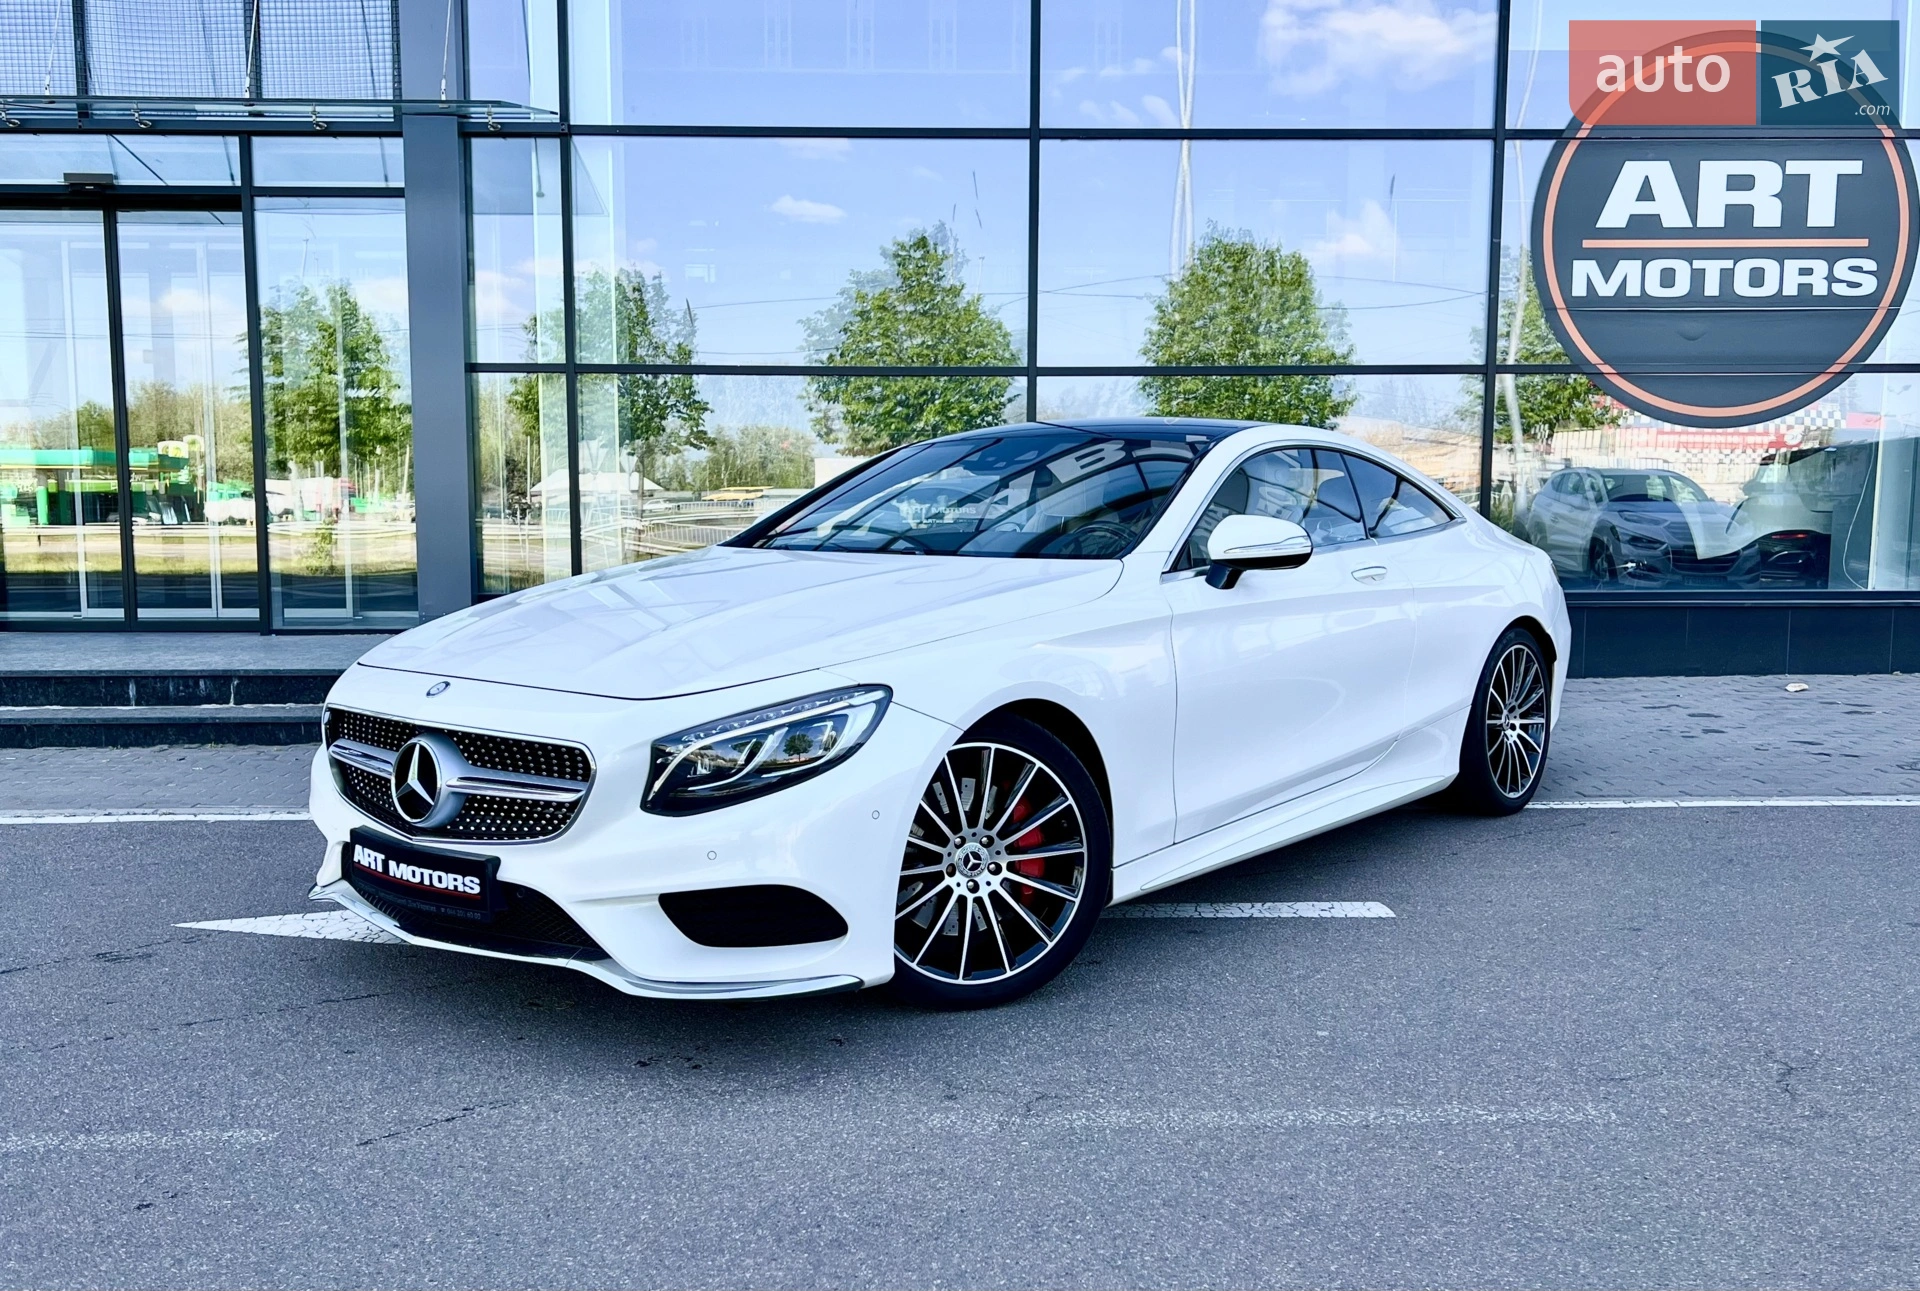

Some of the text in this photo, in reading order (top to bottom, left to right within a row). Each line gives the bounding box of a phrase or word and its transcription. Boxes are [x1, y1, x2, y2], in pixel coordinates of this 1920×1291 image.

[1595, 160, 1864, 228] ART
[1571, 258, 1879, 298] MOTORS
[353, 844, 385, 873] ART
[388, 859, 481, 895] MOTORS
